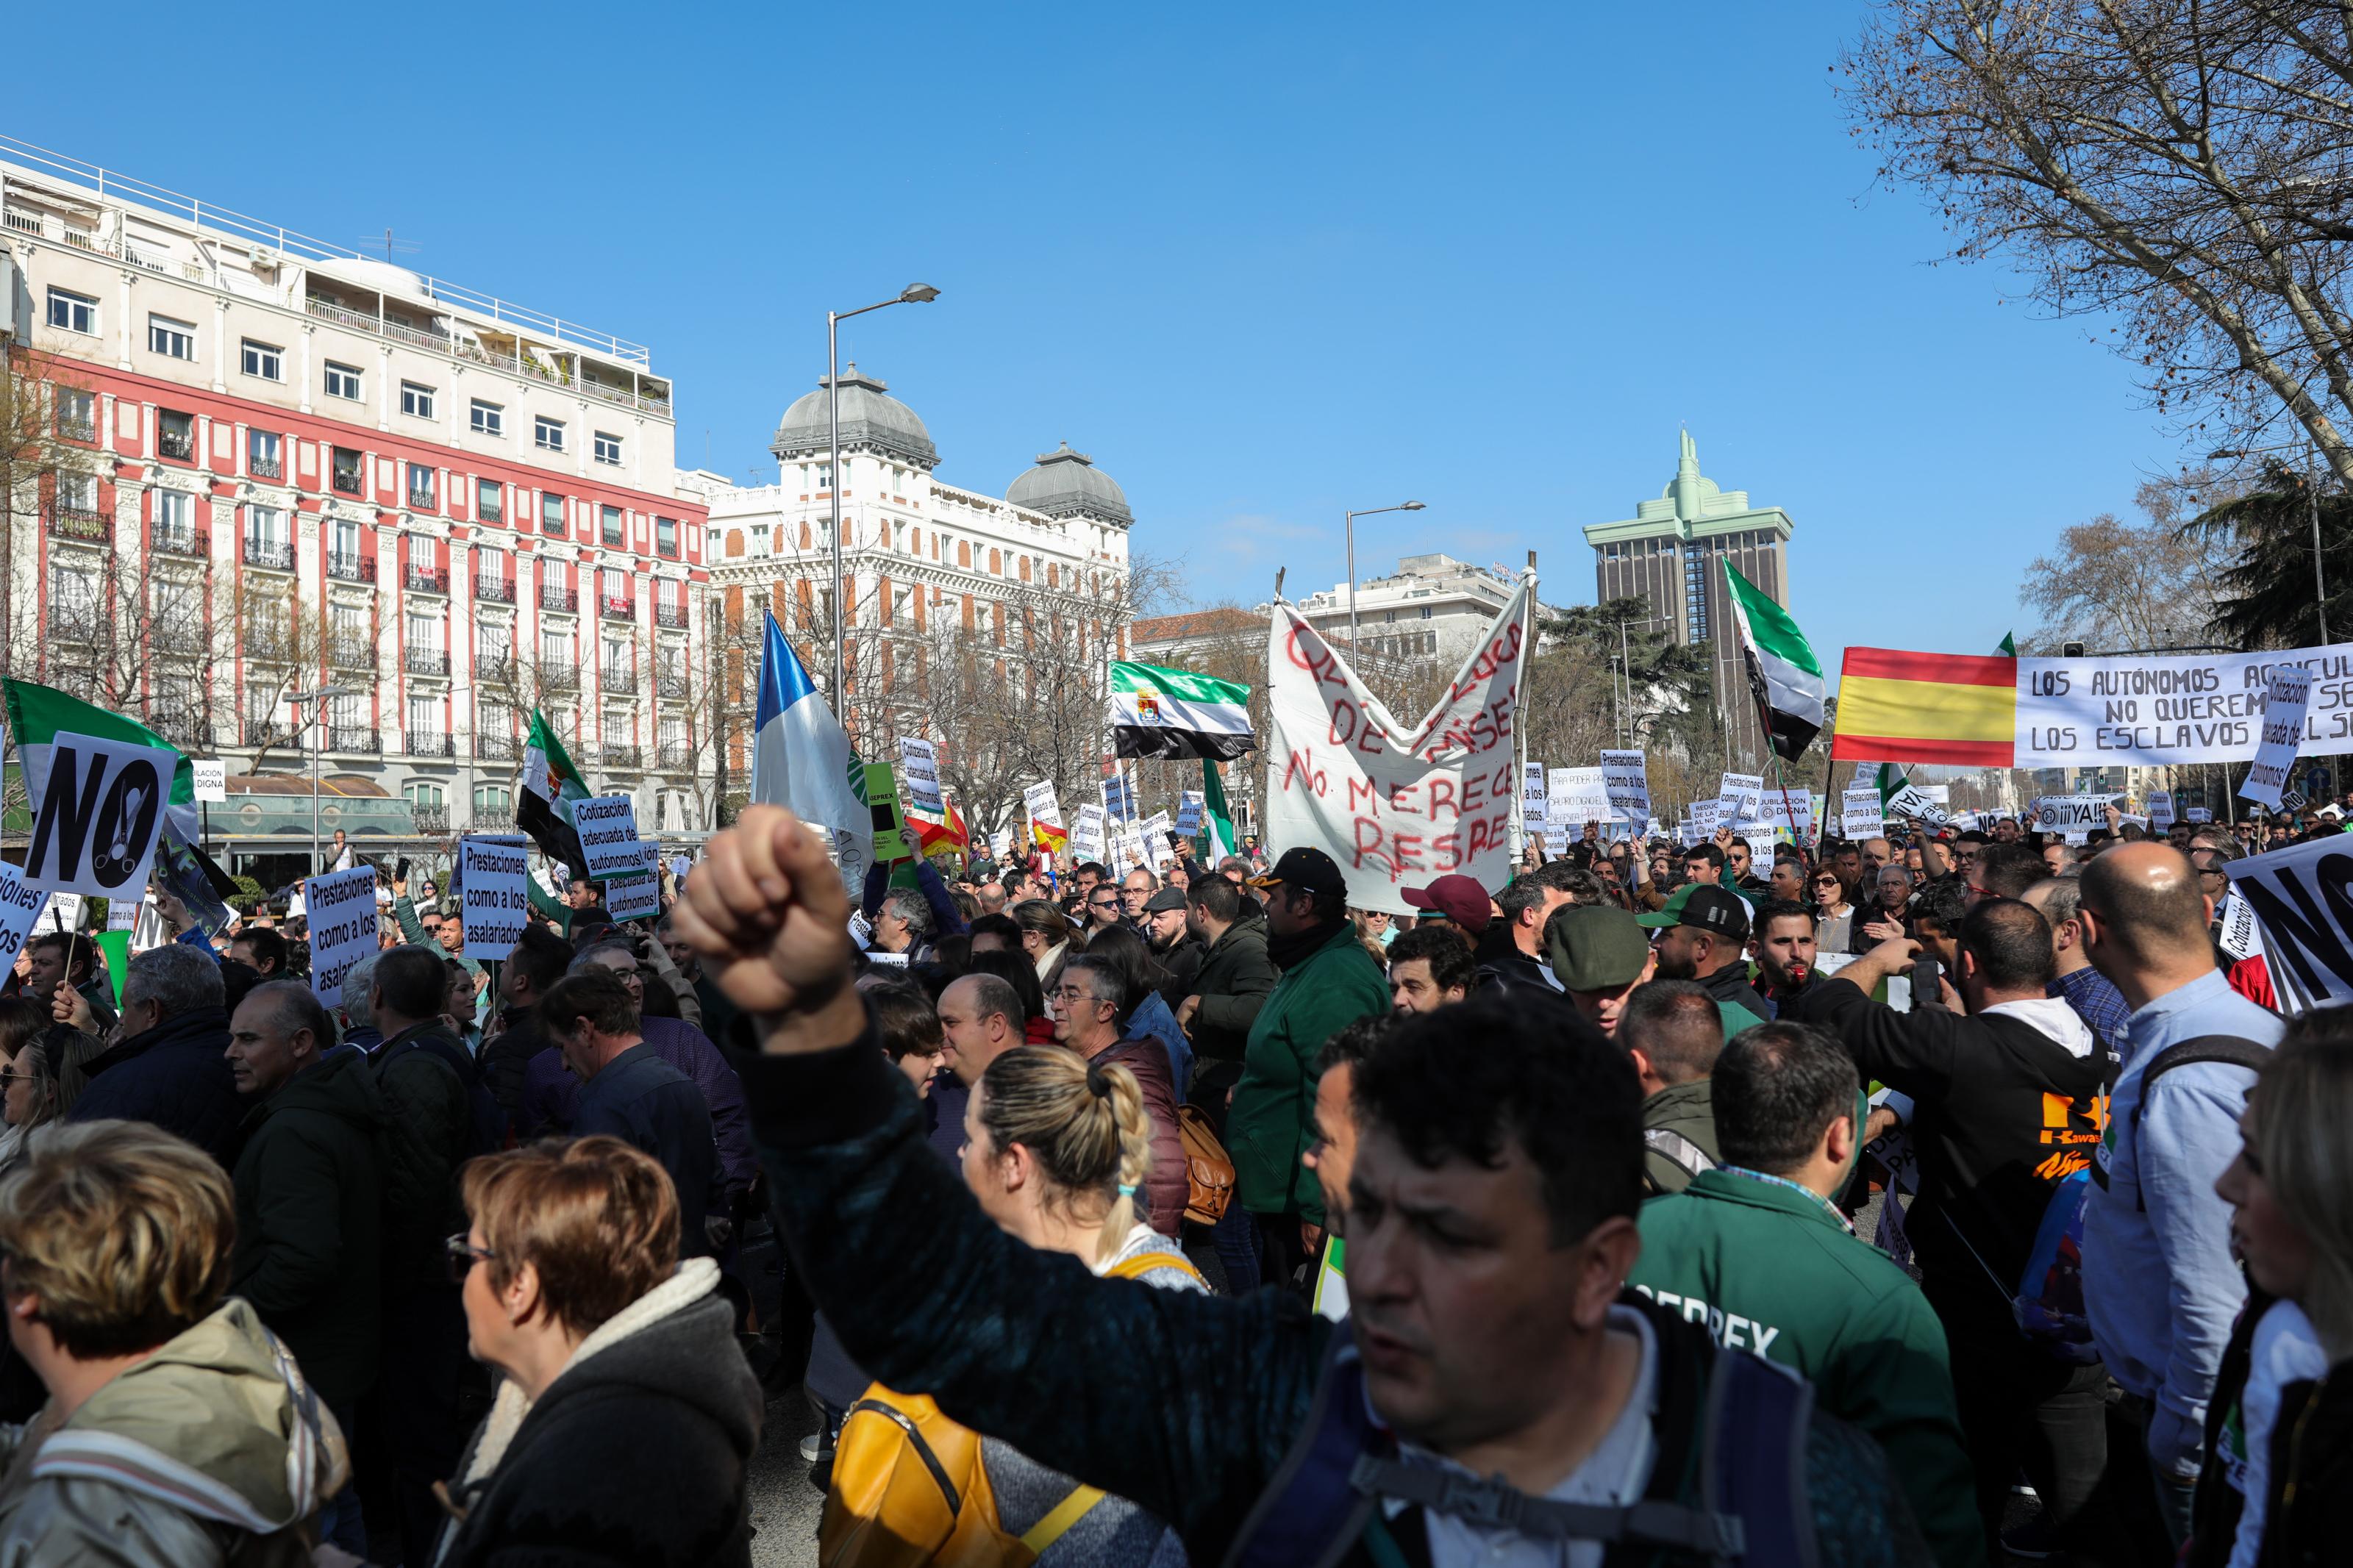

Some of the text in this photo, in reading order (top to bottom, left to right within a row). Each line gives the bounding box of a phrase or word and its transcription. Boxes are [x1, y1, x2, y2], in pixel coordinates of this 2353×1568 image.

[2032, 670, 2071, 697] LOS
[2091, 667, 2219, 695] AUTÓNOMOS
[2106, 699, 2138, 723] NO
[2032, 726, 2077, 751] LOS
[2096, 721, 2249, 751] ESCLAVOS
[2288, 720, 2300, 747] de
[1603, 753, 1643, 767] Prestaciones
[929, 767, 936, 782] de
[1570, 775, 1590, 785] PODER
[1607, 774, 1645, 788] como a los
[197, 779, 224, 788] DIGNA
[1724, 775, 1760, 790] Prestaciones
[1525, 786, 1543, 800] a los
[1550, 796, 1575, 806] SALARIO
[1576, 795, 1595, 805] DIGNO
[1721, 794, 1757, 806] como los
[1844, 790, 1879, 803] Prestaciones
[2285, 792, 2304, 808] NO
[1049, 799, 1056, 808] de
[1696, 803, 1718, 811] REDUC
[1760, 797, 1806, 806] JUBILACIÓN
[26, 746, 160, 889] NO
[576, 801, 631, 826] ¡Cotización
[1550, 812, 1579, 823] NECESITA
[1846, 809, 1864, 818] como
[1871, 806, 1881, 815] los
[1139, 813, 1167, 832] Prestaciones
[1848, 820, 1882, 833] asalariados.
[582, 825, 638, 846] adecuada de
[1094, 828, 1100, 837] de
[643, 845, 657, 862] ión
[1754, 843, 1772, 856] a los
[466, 847, 526, 876] Prestaciones
[590, 849, 645, 871] autónomos!
[648, 868, 657, 883] de
[0, 870, 42, 910] iones
[311, 874, 374, 910] Prestaciones
[467, 887, 525, 910] como a los
[610, 889, 657, 914] autónomos!
[110, 912, 122, 920] como
[126, 909, 135, 920] los
[318, 911, 376, 951] como a los
